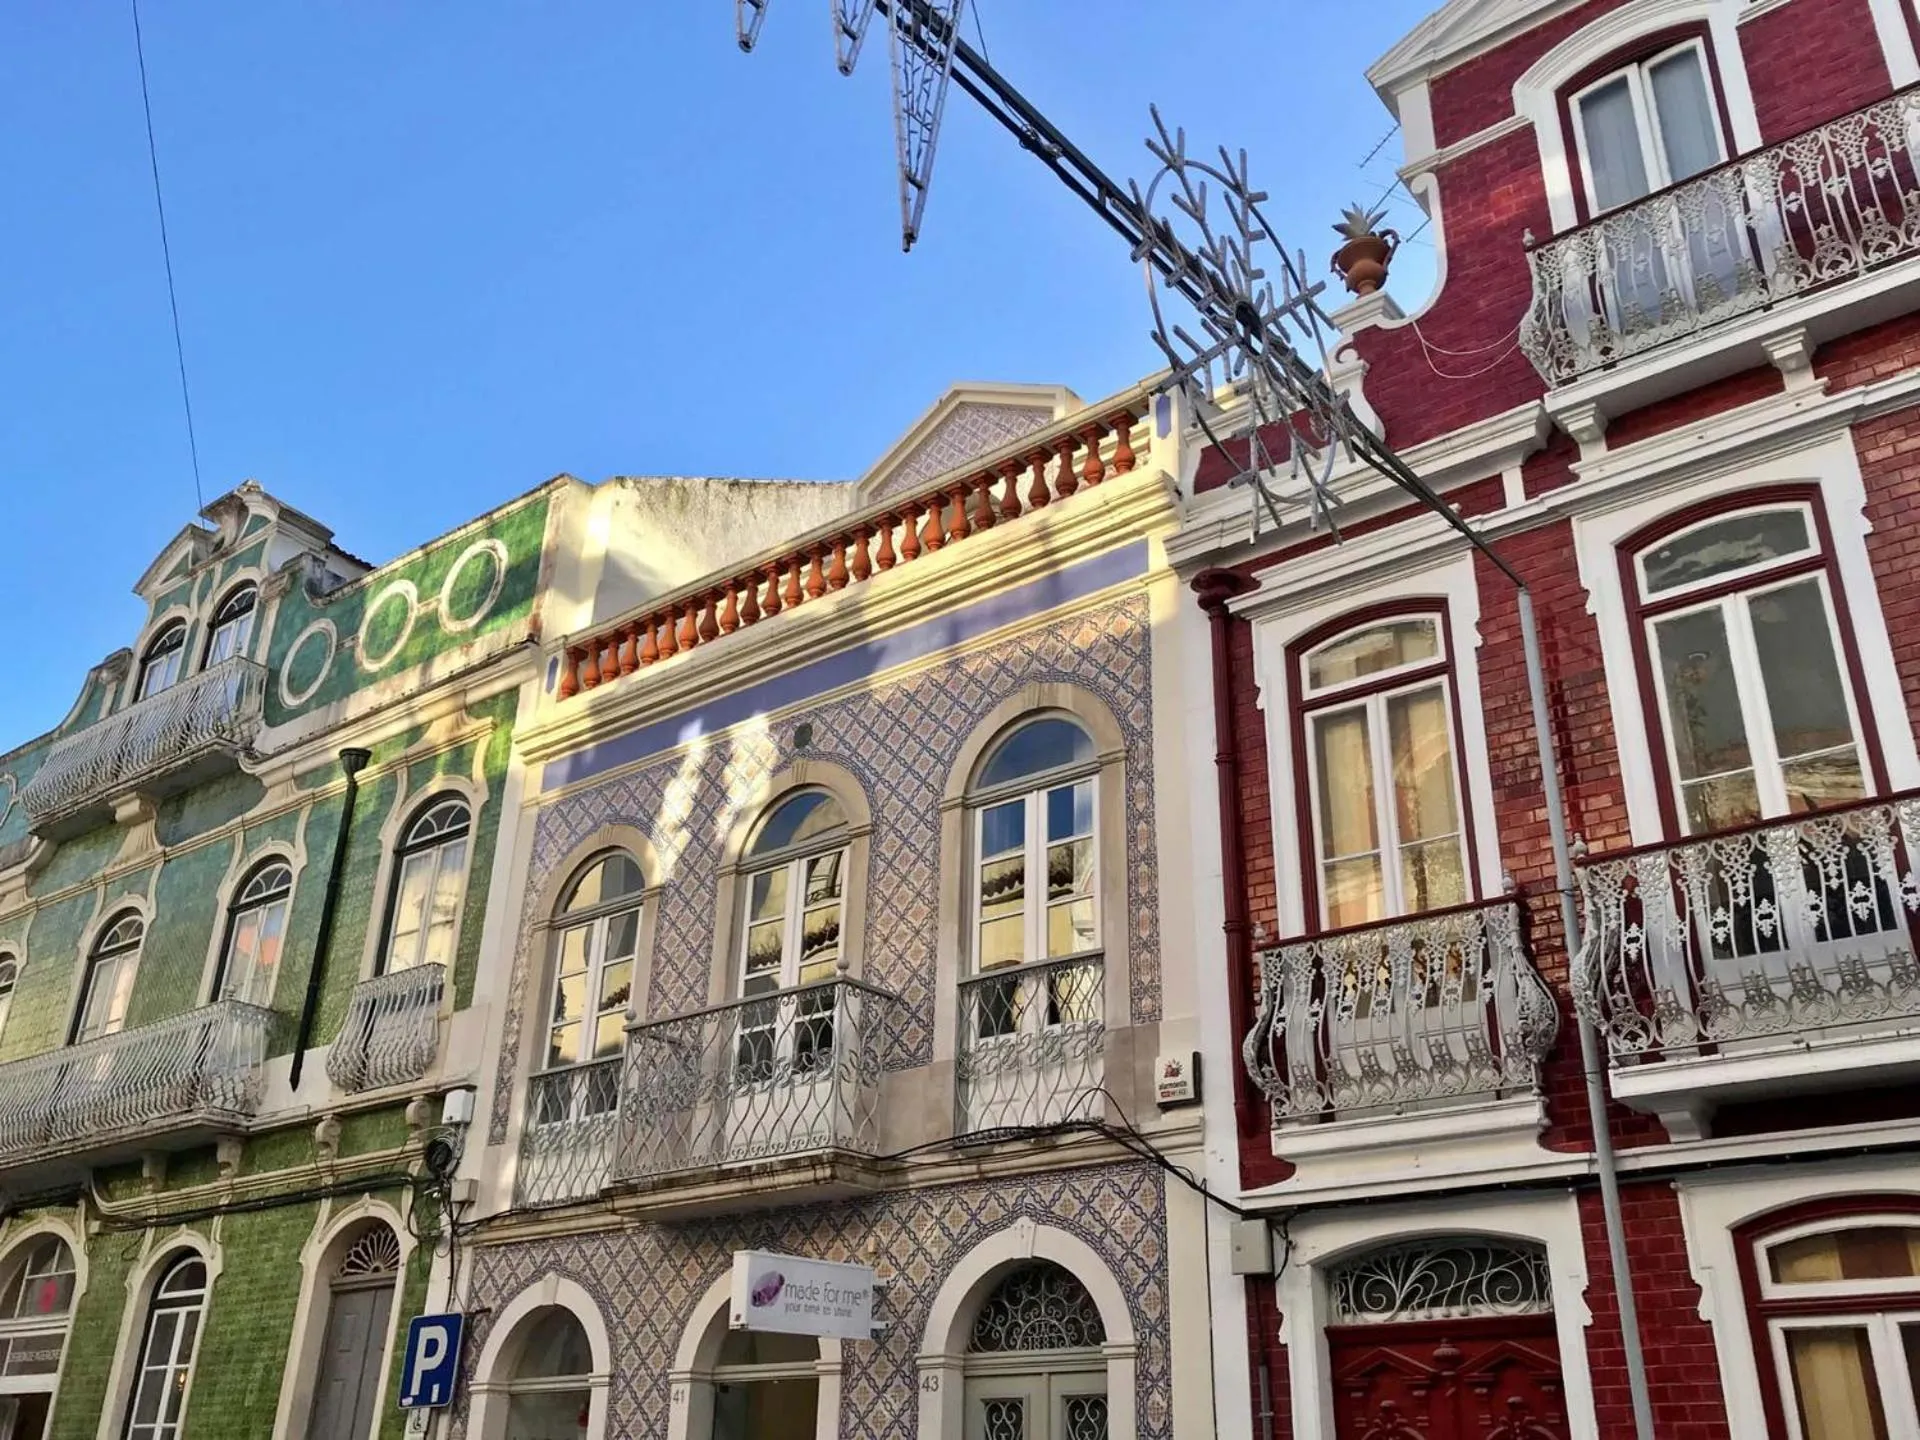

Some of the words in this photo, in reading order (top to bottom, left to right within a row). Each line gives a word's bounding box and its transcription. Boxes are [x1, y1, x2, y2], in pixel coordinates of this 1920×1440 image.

[785, 1280, 820, 1301] made
[824, 1281, 840, 1303] for
[784, 1303, 800, 1313] your
[410, 1325, 448, 1396] P
[921, 1375, 939, 1392] 43
[673, 1388, 685, 1404] 41
